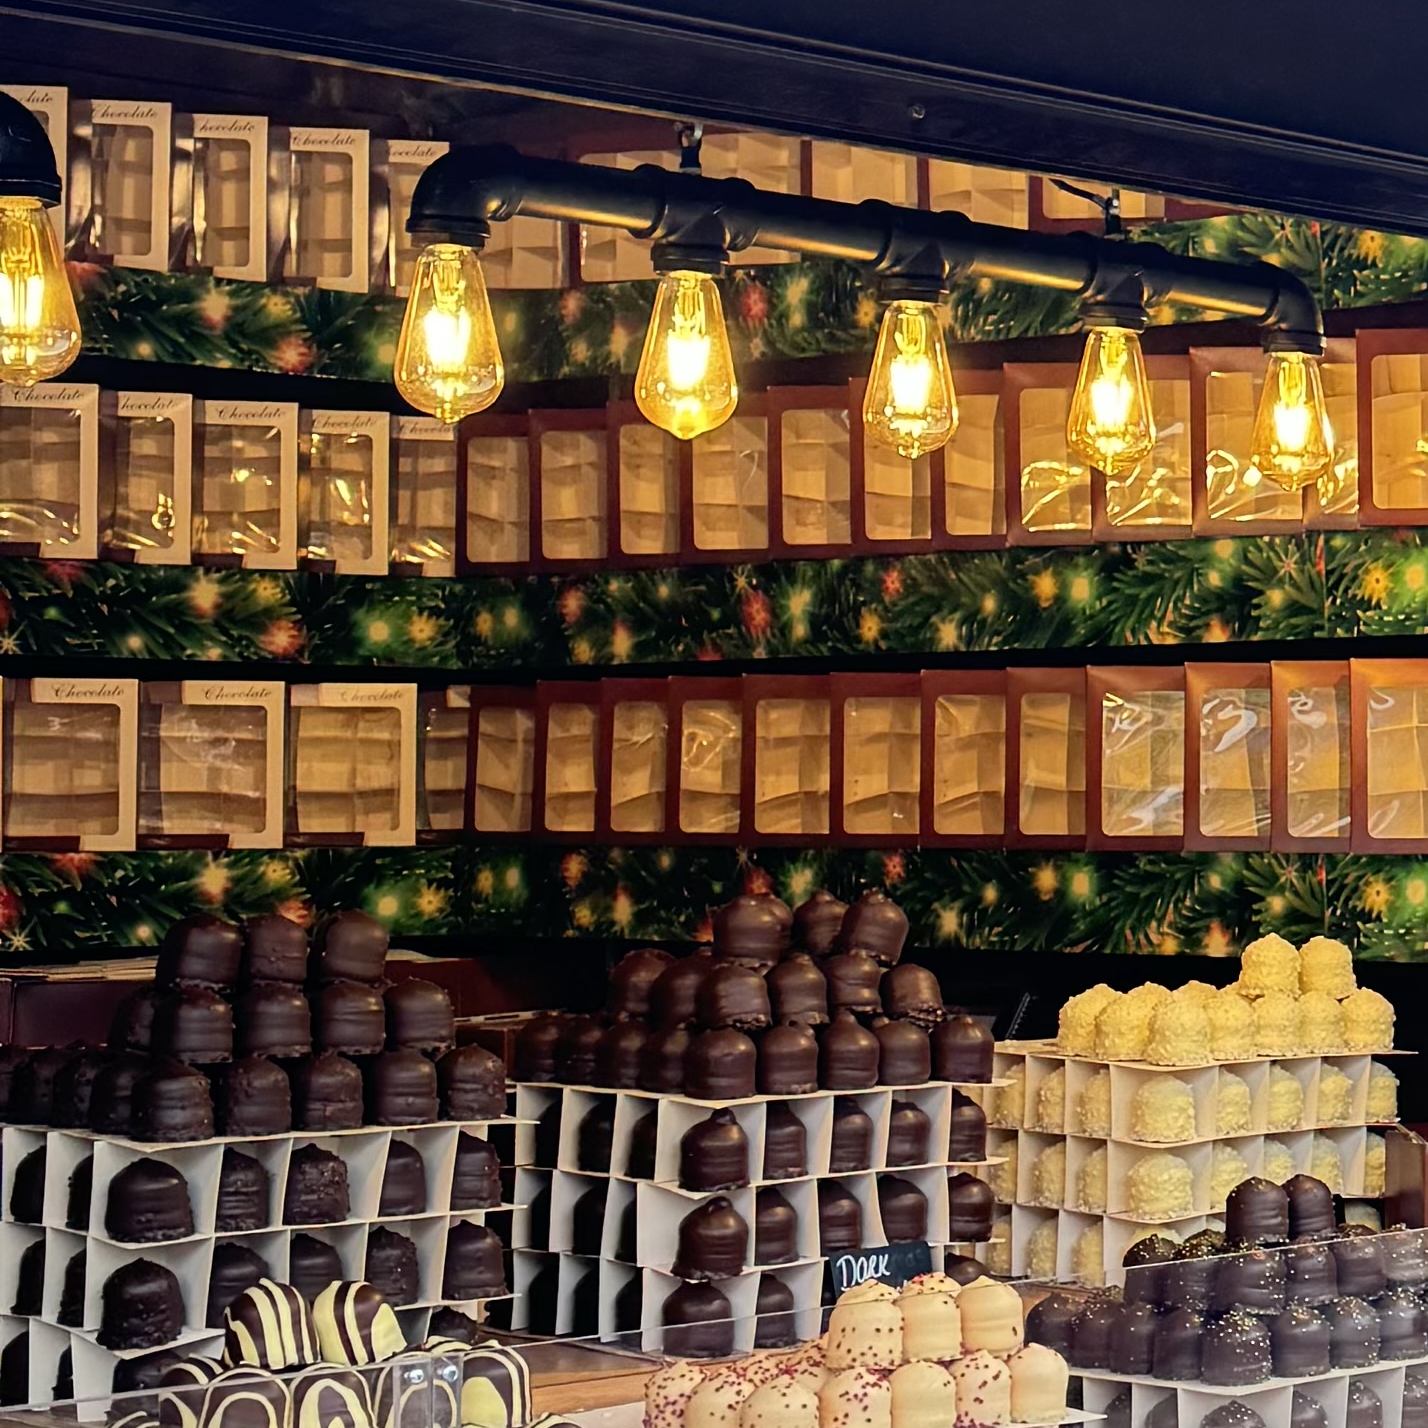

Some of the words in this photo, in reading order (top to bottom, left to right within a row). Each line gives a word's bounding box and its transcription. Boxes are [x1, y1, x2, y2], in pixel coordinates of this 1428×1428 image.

[12, 388, 85, 402] Chocolate
[217, 406, 287, 420] Chocolate
[51, 683, 125, 700] Chocolate
[203, 685, 272, 700] Chocolate
